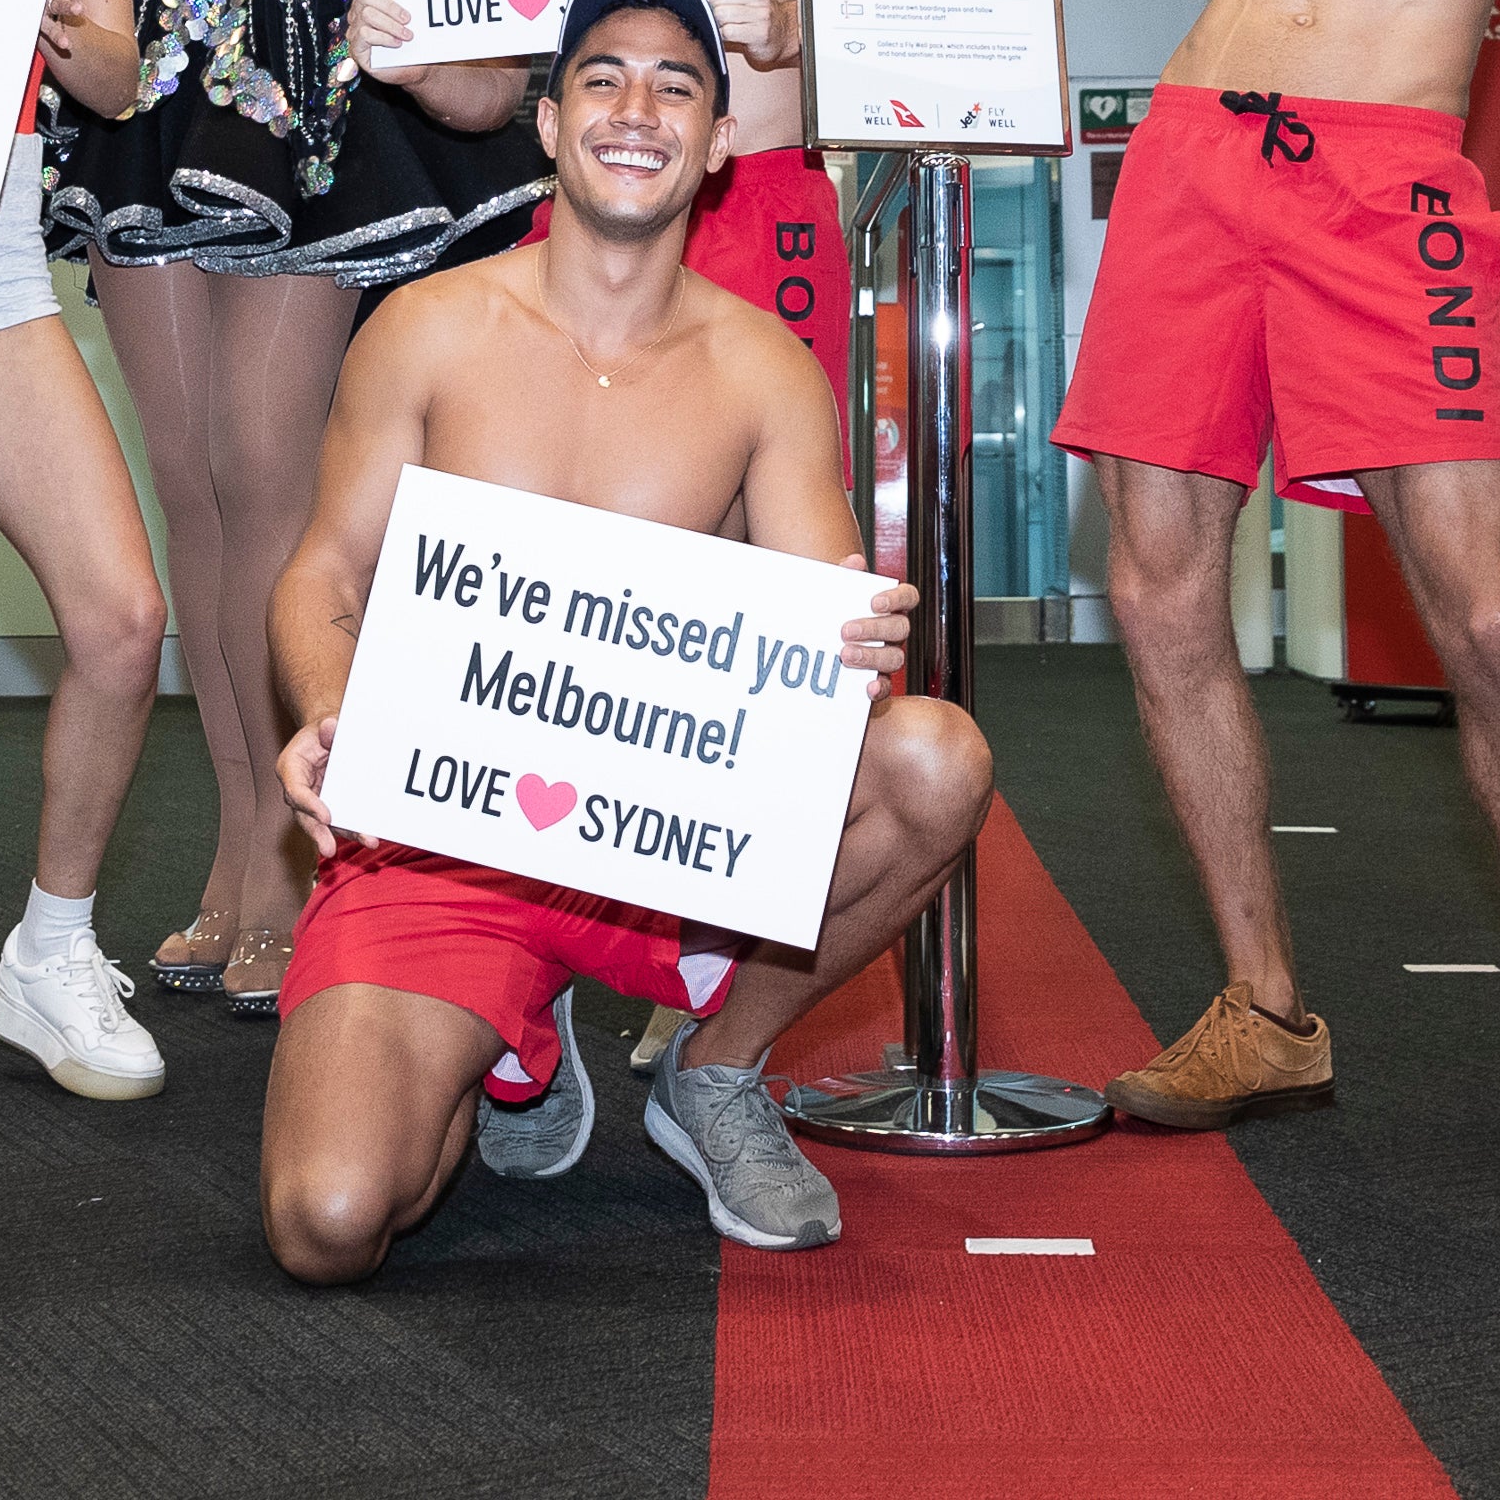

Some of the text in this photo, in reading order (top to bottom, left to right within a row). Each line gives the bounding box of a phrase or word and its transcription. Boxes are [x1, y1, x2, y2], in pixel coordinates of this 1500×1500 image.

[864, 105, 881, 113] FLY
[989, 108, 1005, 116] FLY
[865, 117, 892, 125] WELL
[960, 111, 977, 129] Jet
[989, 119, 1016, 128] WELL
[415, 534, 841, 698] We've missed you
[460, 642, 746, 769] Melbourne!
[404, 748, 751, 877] LOVE SYDNEY
